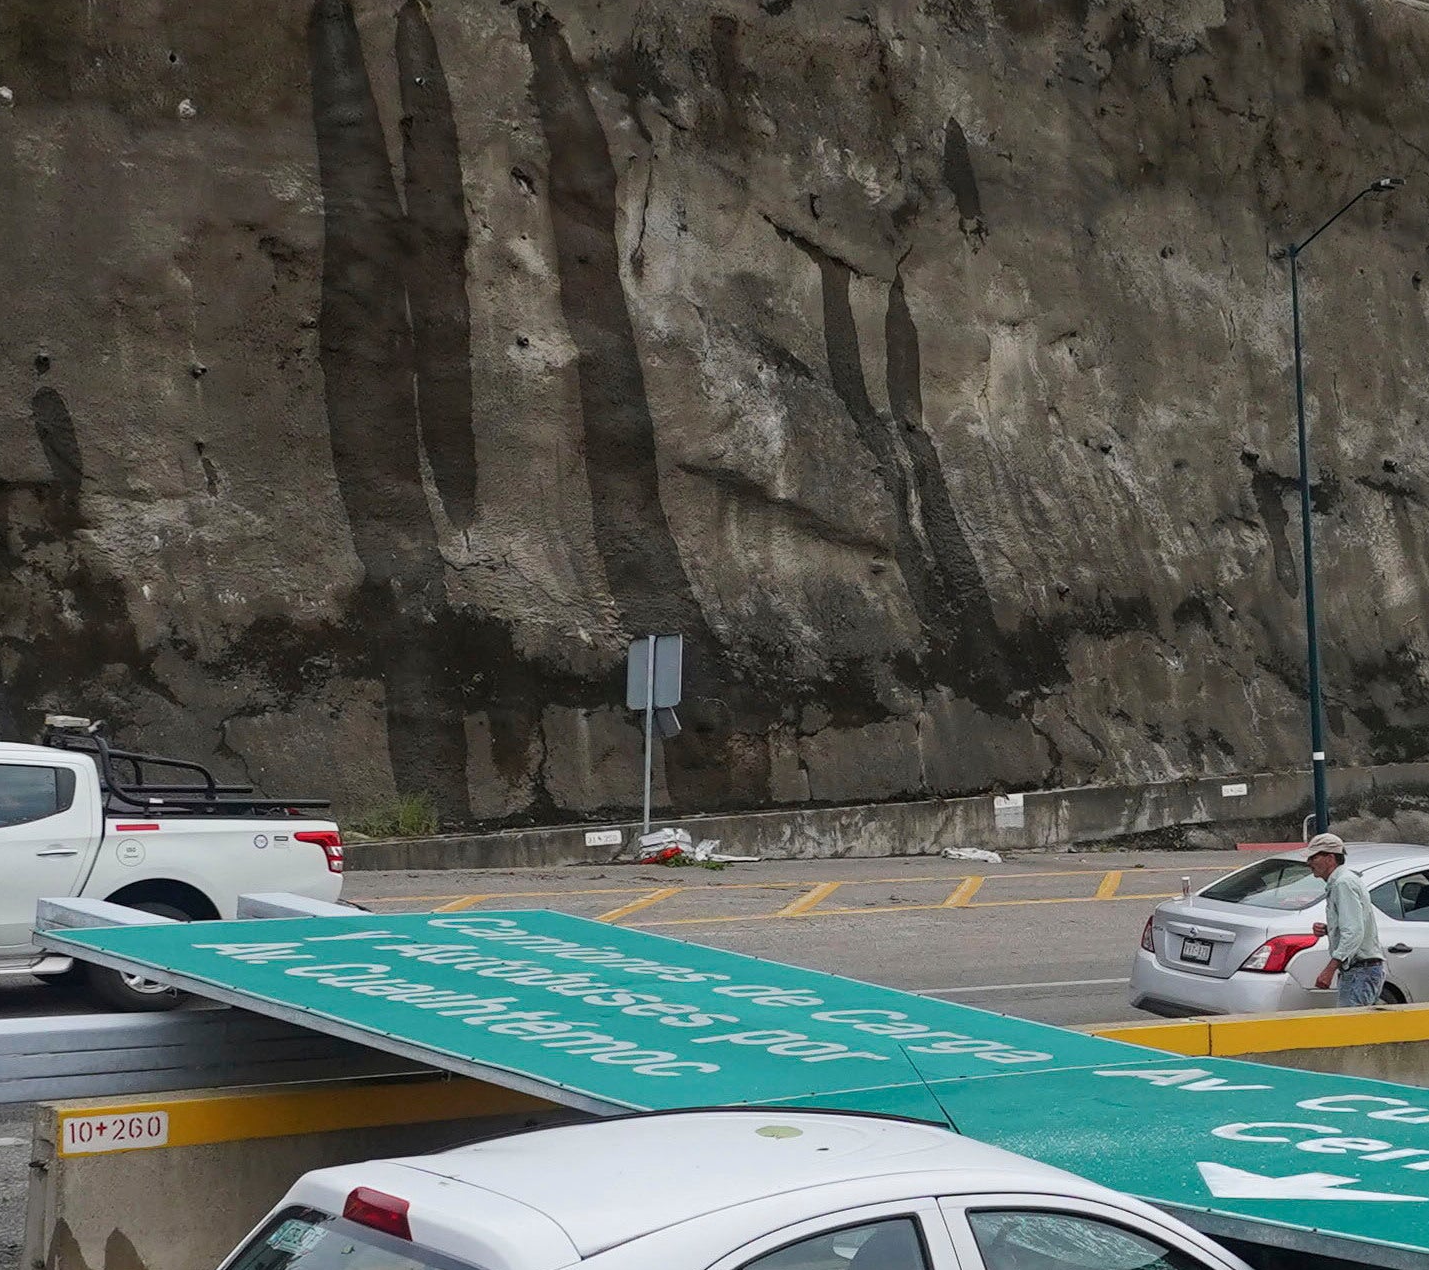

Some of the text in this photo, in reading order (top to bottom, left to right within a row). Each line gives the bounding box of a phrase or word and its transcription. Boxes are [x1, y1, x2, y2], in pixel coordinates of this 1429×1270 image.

[192, 943, 720, 1076] Av. Cuauhtémoc
[305, 931, 889, 1062] Y Autobuses por
[428, 918, 1053, 1064] Camiones de Carga
[69, 1116, 161, 1144] 10+260
[1094, 1069, 1273, 1092] Av
